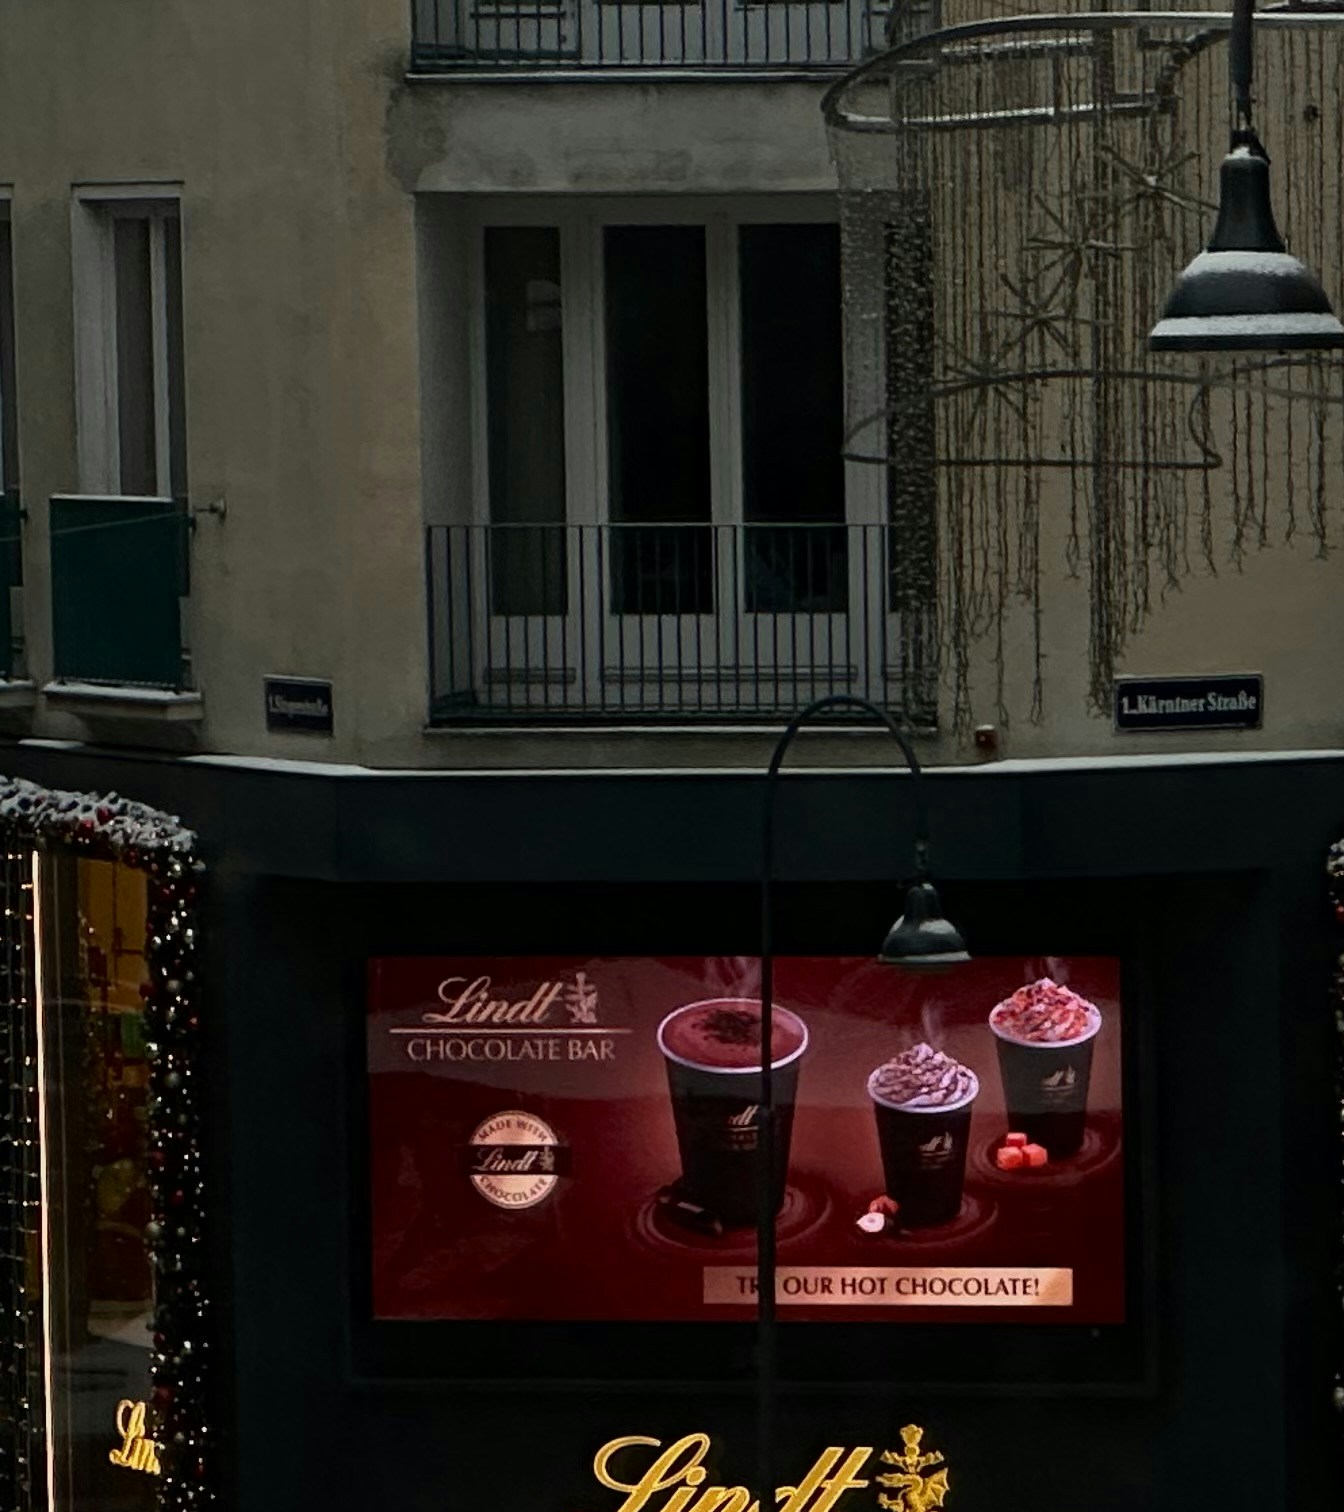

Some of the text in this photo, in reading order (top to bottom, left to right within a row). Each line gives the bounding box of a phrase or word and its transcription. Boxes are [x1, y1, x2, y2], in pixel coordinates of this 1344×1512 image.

[1206, 689, 1257, 712] Straße
[421, 975, 565, 1024] Lindt
[407, 1038, 616, 1061] CHOCOLATE BAR
[478, 1119, 548, 1142] MADE WITH
[470, 1146, 540, 1172] Lindt
[481, 1175, 548, 1202] CHOCOLATE
[736, 1275, 1040, 1296] TR OUR HOT CHOCOLATE!
